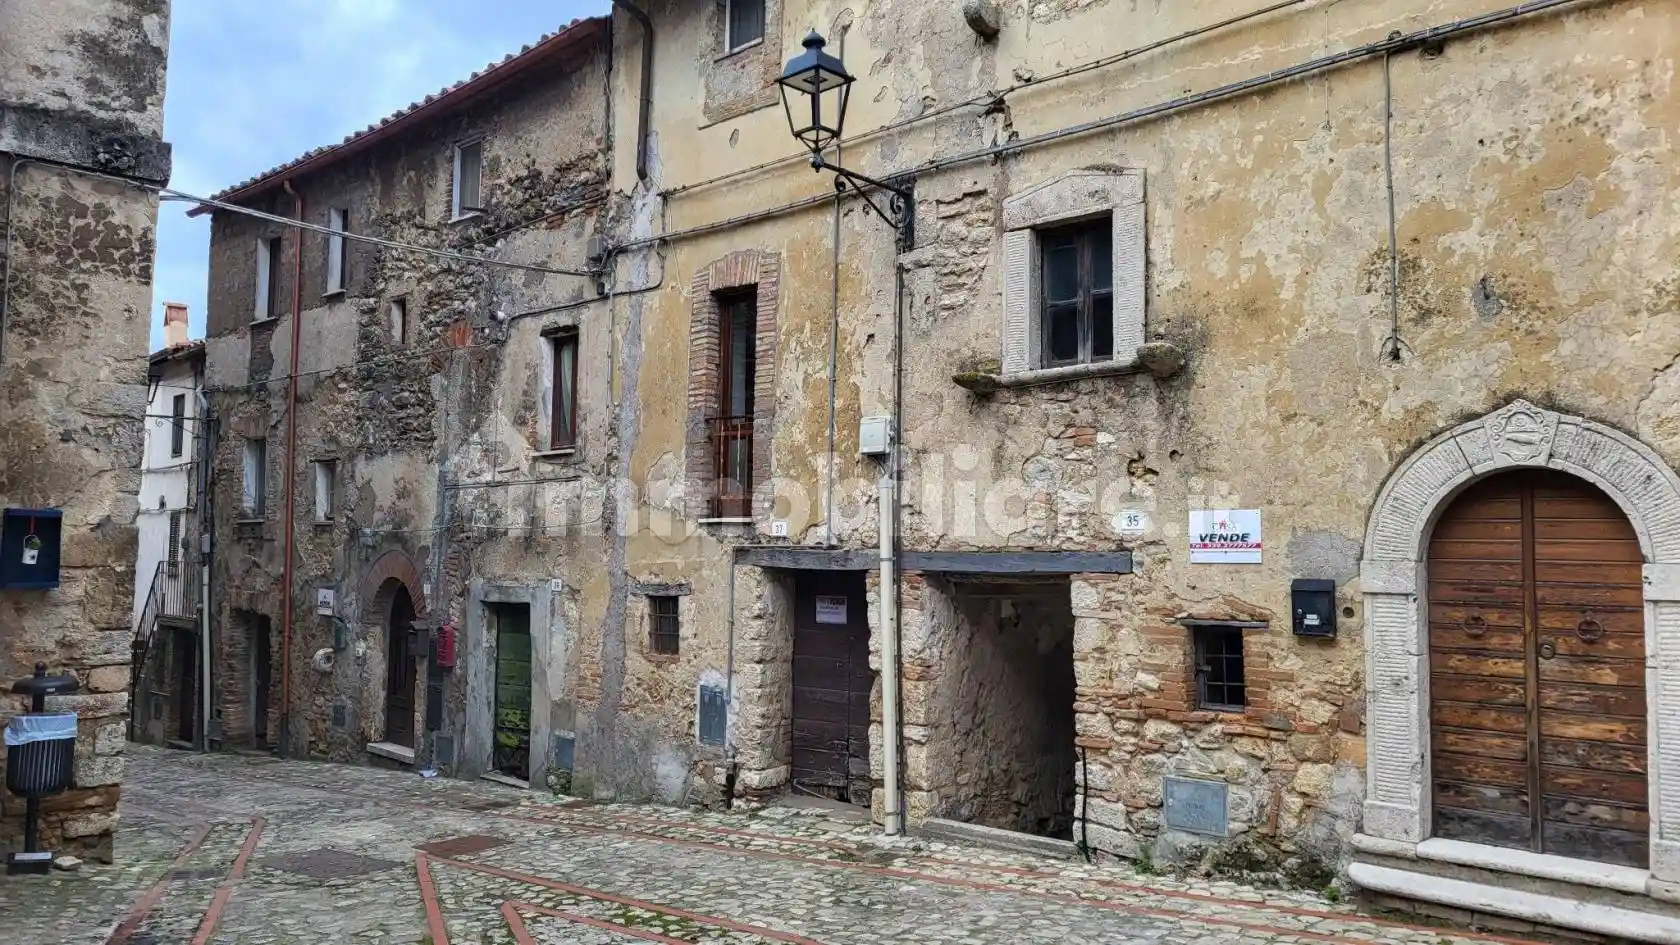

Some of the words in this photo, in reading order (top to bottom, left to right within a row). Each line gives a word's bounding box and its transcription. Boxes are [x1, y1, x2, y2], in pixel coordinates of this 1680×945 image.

[1126, 513, 1140, 527] 35
[775, 524, 783, 534] 37
[1199, 533, 1251, 542] VENDE
